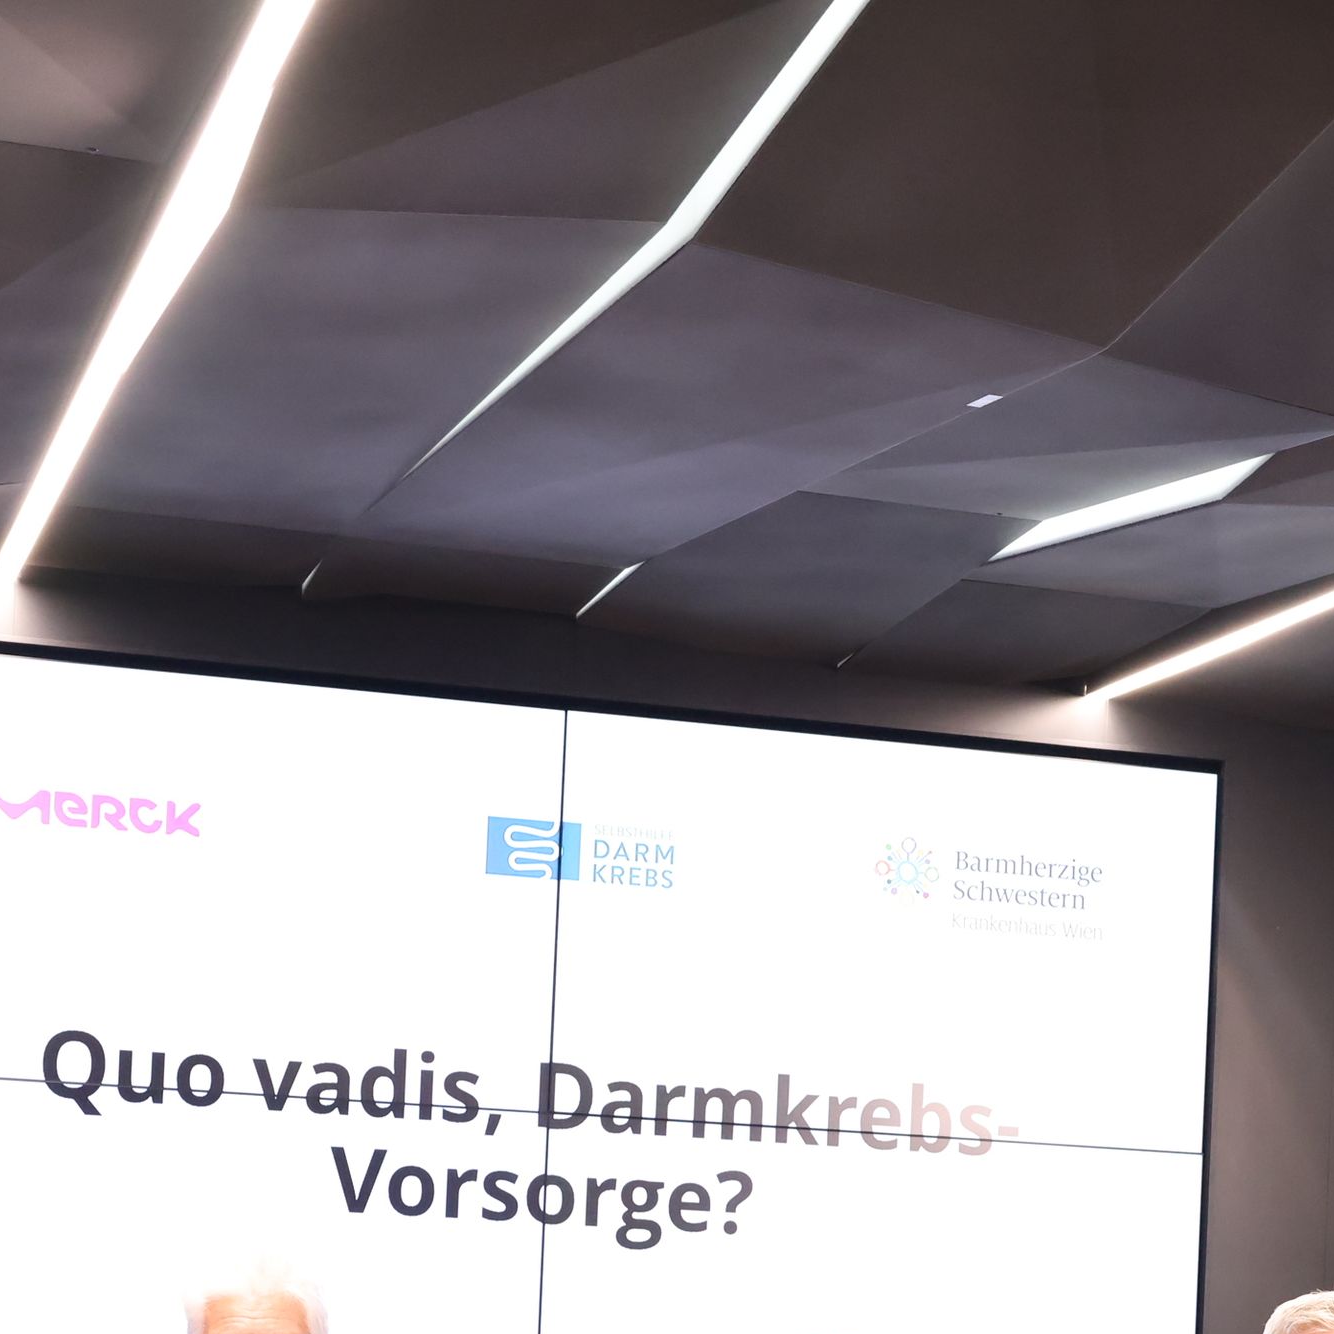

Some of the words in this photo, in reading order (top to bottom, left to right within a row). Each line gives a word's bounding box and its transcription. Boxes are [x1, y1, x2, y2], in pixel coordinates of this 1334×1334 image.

[593, 839, 675, 865] DARM
[592, 863, 674, 889] KREBS
[955, 850, 1103, 887] Barmherzige
[953, 879, 1086, 911] Schwestern
[951, 912, 1057, 939] Krankenhaus
[1062, 922, 1104, 942] Wien
[42, 1030, 224, 1116] Quo
[253, 1048, 502, 1136] vadis,
[538, 1061, 1019, 1156] Darmkrebs-
[330, 1146, 753, 1250] Vorsorge?
